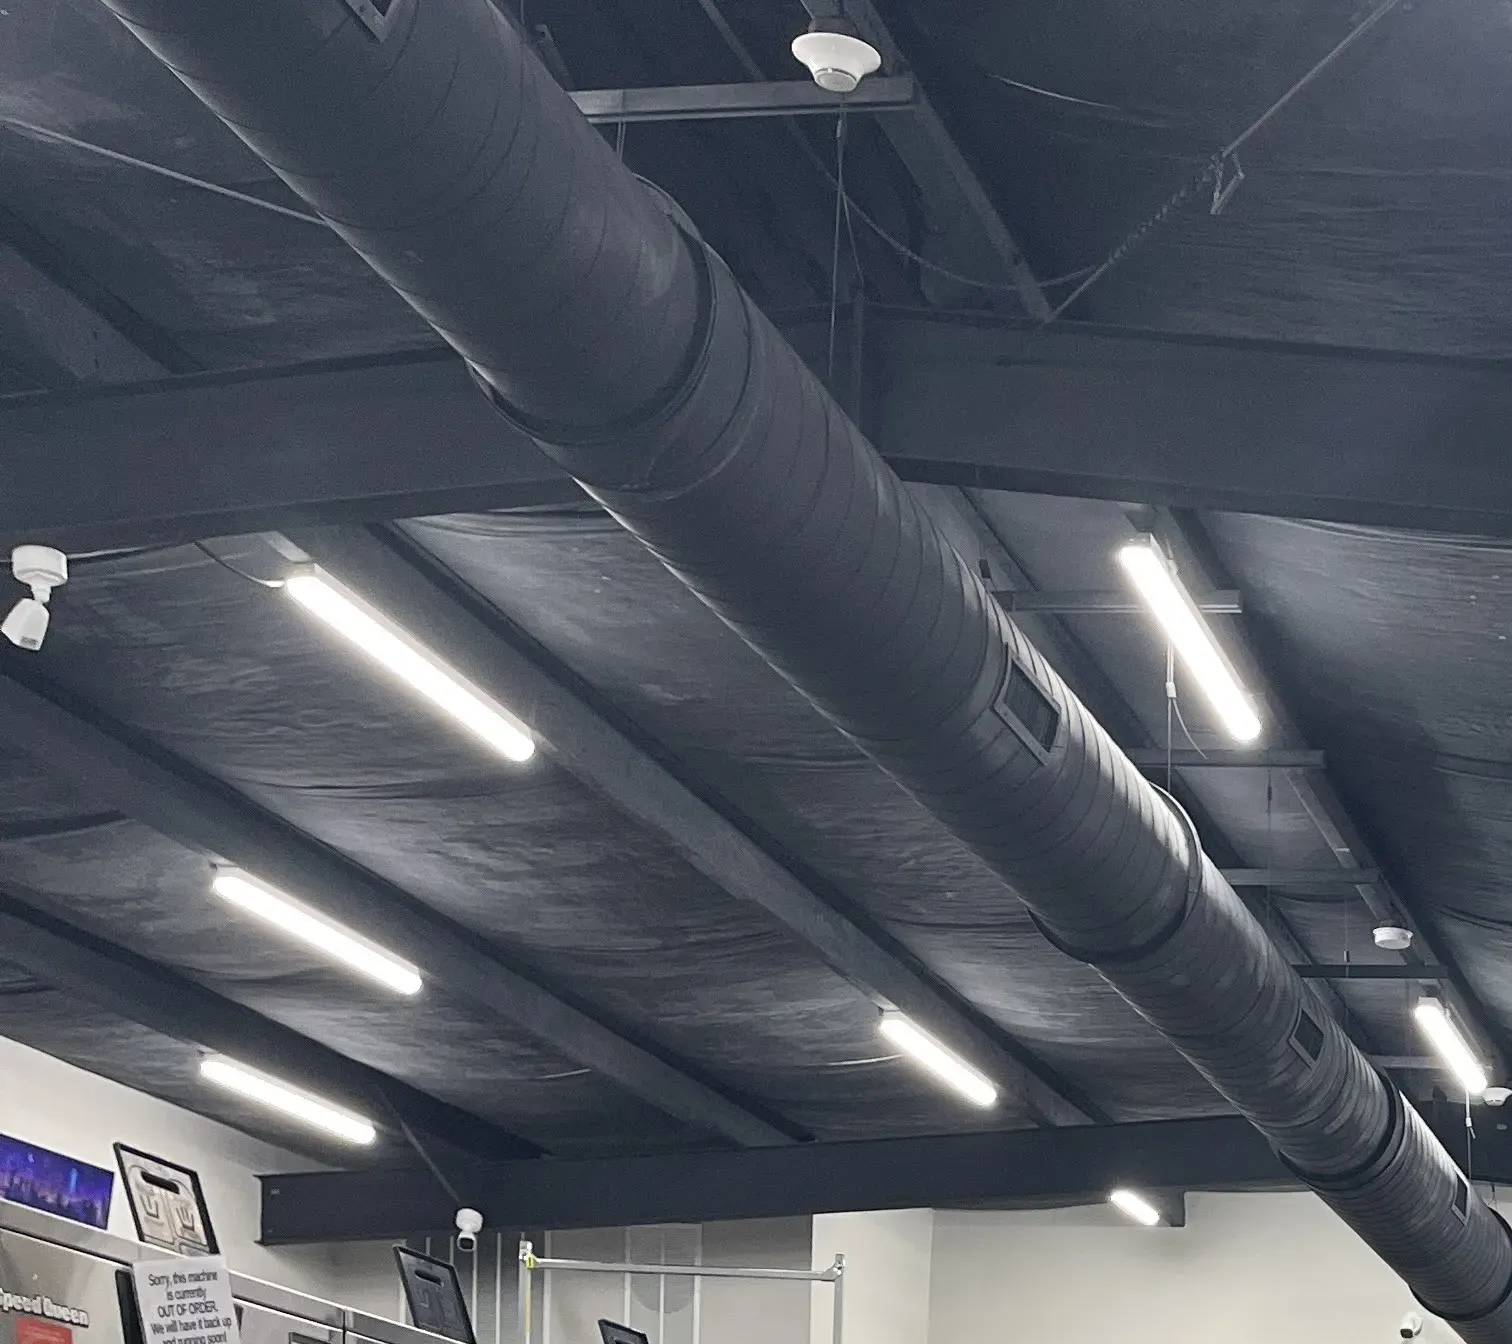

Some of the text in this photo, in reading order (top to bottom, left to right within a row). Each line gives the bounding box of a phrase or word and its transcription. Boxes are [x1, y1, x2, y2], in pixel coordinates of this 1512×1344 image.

[148, 1269, 218, 1291] Sorry, this machine
[166, 1286, 207, 1301] is currently
[0, 1286, 90, 1328] peed Queen
[157, 1304, 176, 1318] OUT
[176, 1303, 188, 1316] OF
[150, 1322, 165, 1335] We
[164, 1320, 178, 1333] will
[178, 1319, 197, 1332] have
[204, 1316, 221, 1329] back
[221, 1317, 232, 1329] up
